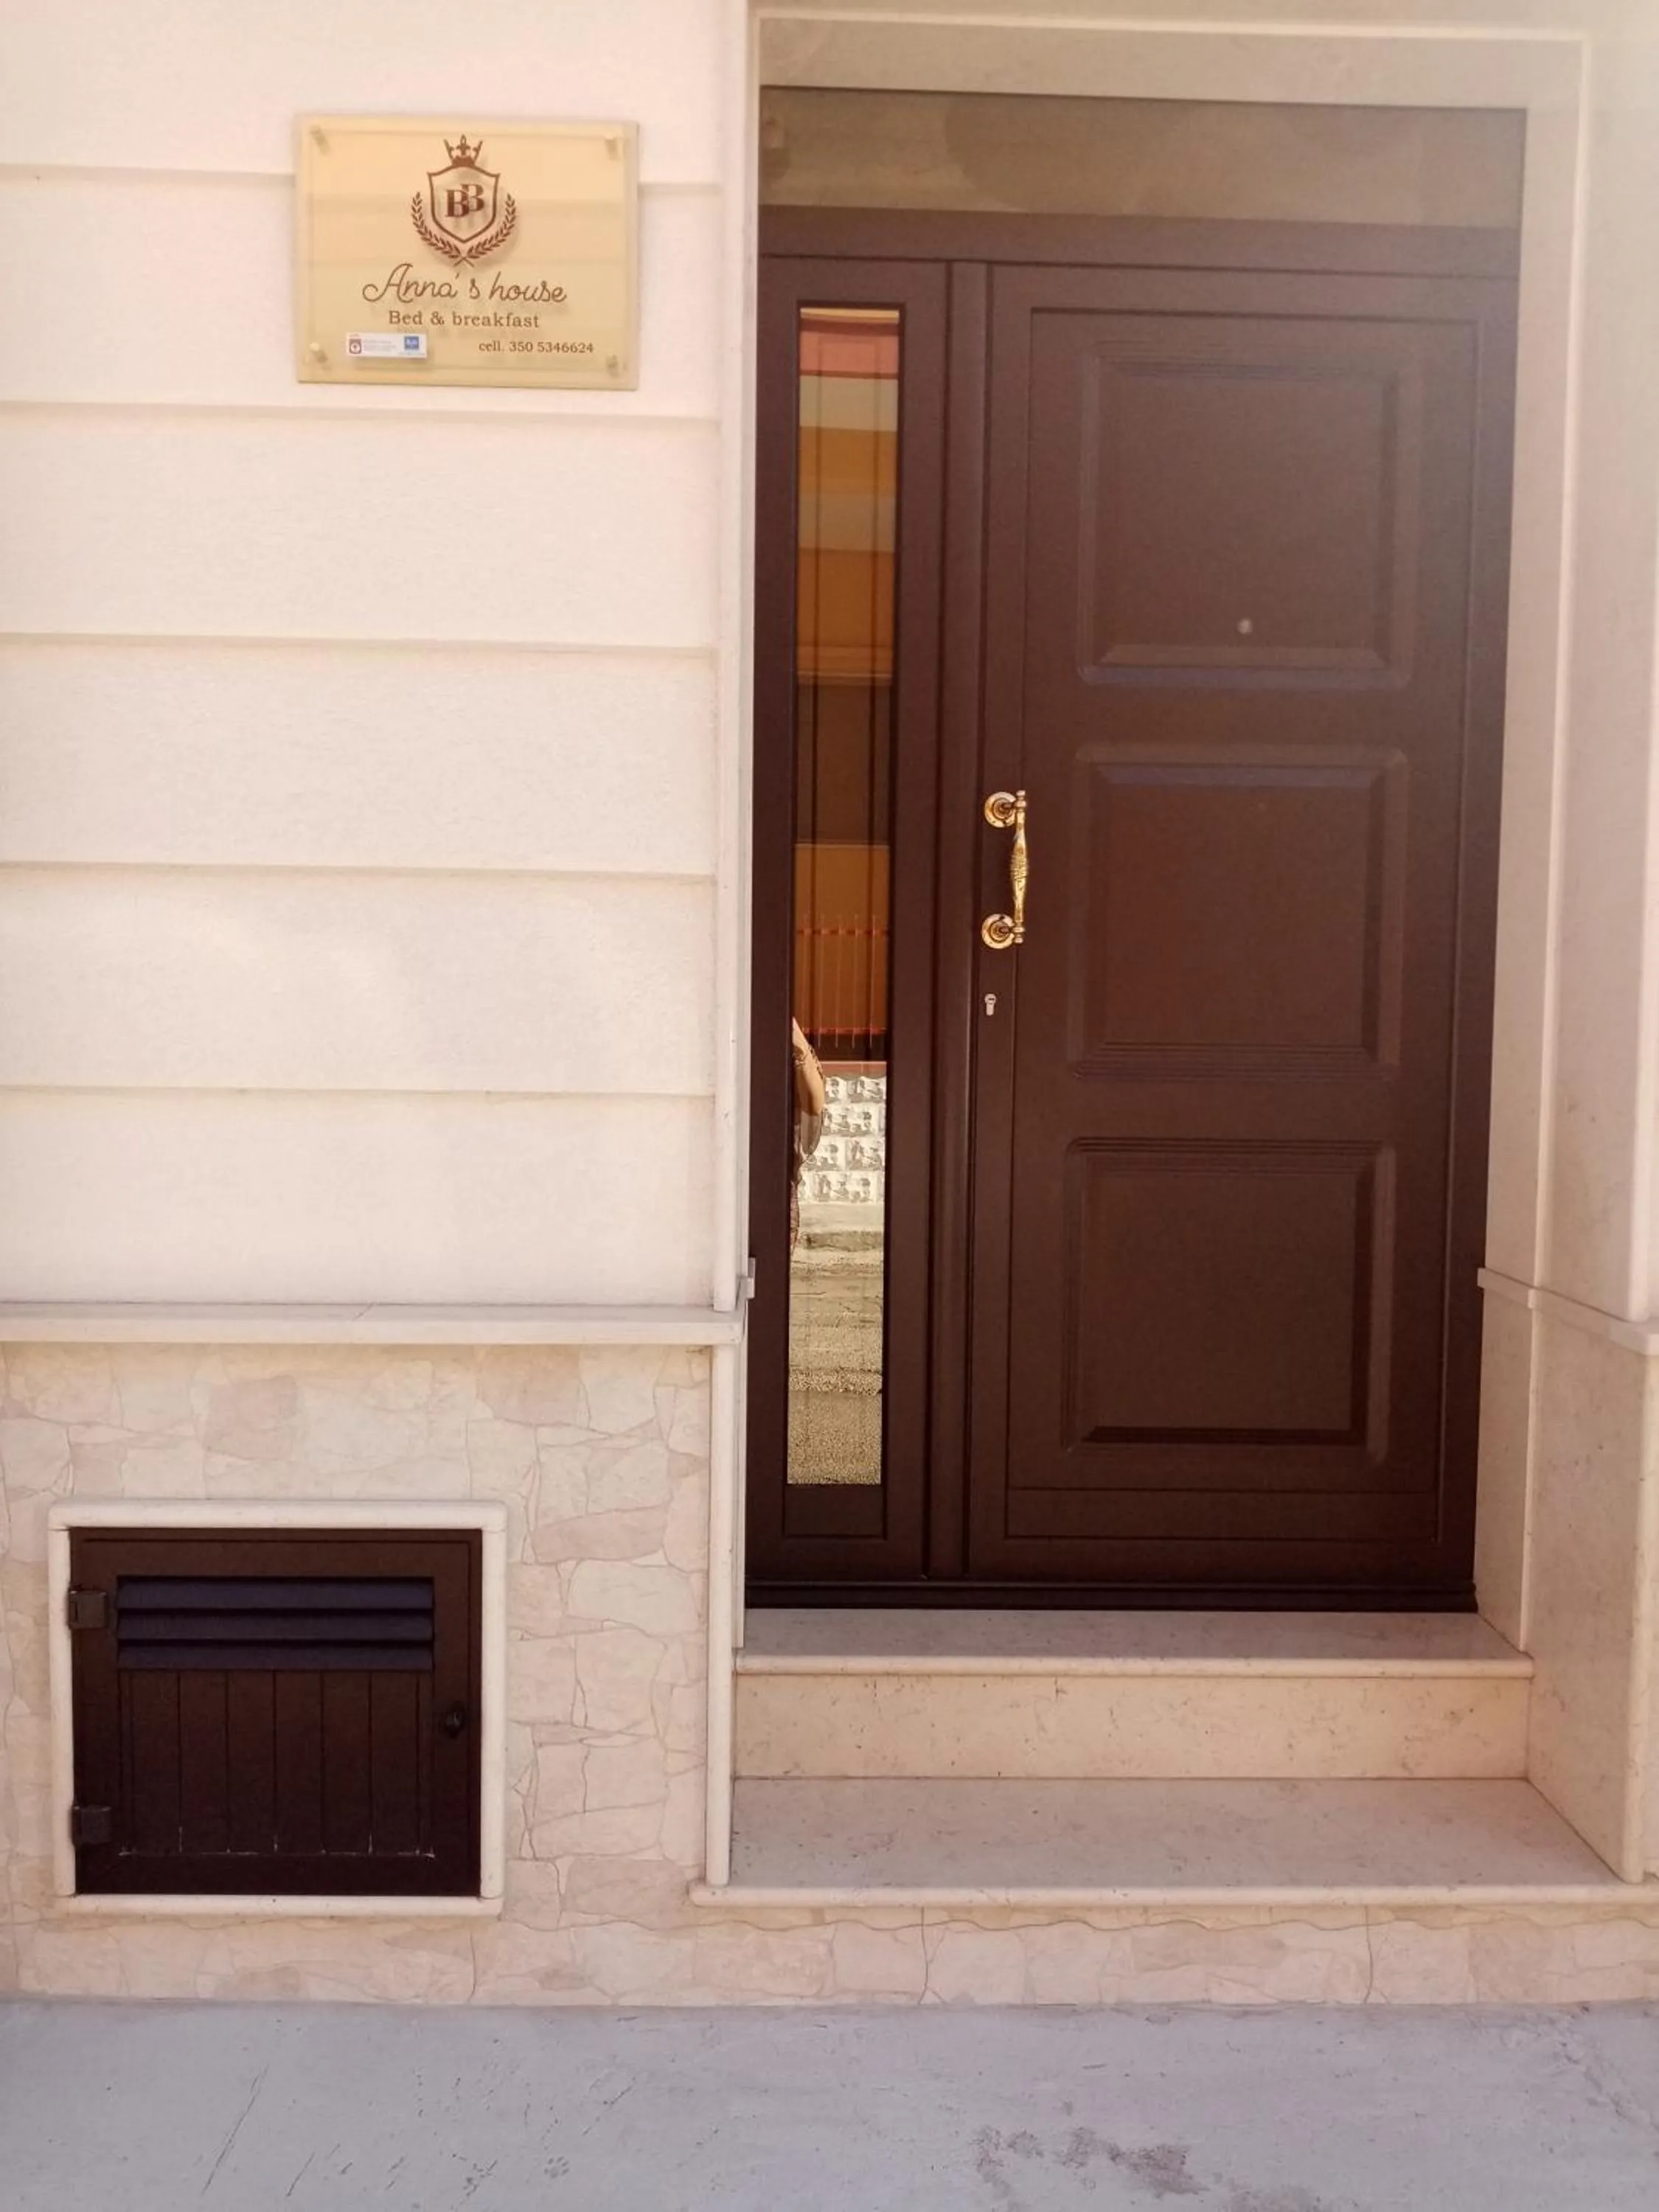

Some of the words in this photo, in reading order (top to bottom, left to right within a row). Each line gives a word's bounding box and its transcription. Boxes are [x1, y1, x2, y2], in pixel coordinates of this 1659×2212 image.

[491, 271, 567, 303] house
[388, 310, 422, 326] Bed
[431, 311, 445, 325] &
[452, 310, 540, 329] breakfast
[509, 341, 533, 352] 350
[537, 341, 594, 353] 5346624
